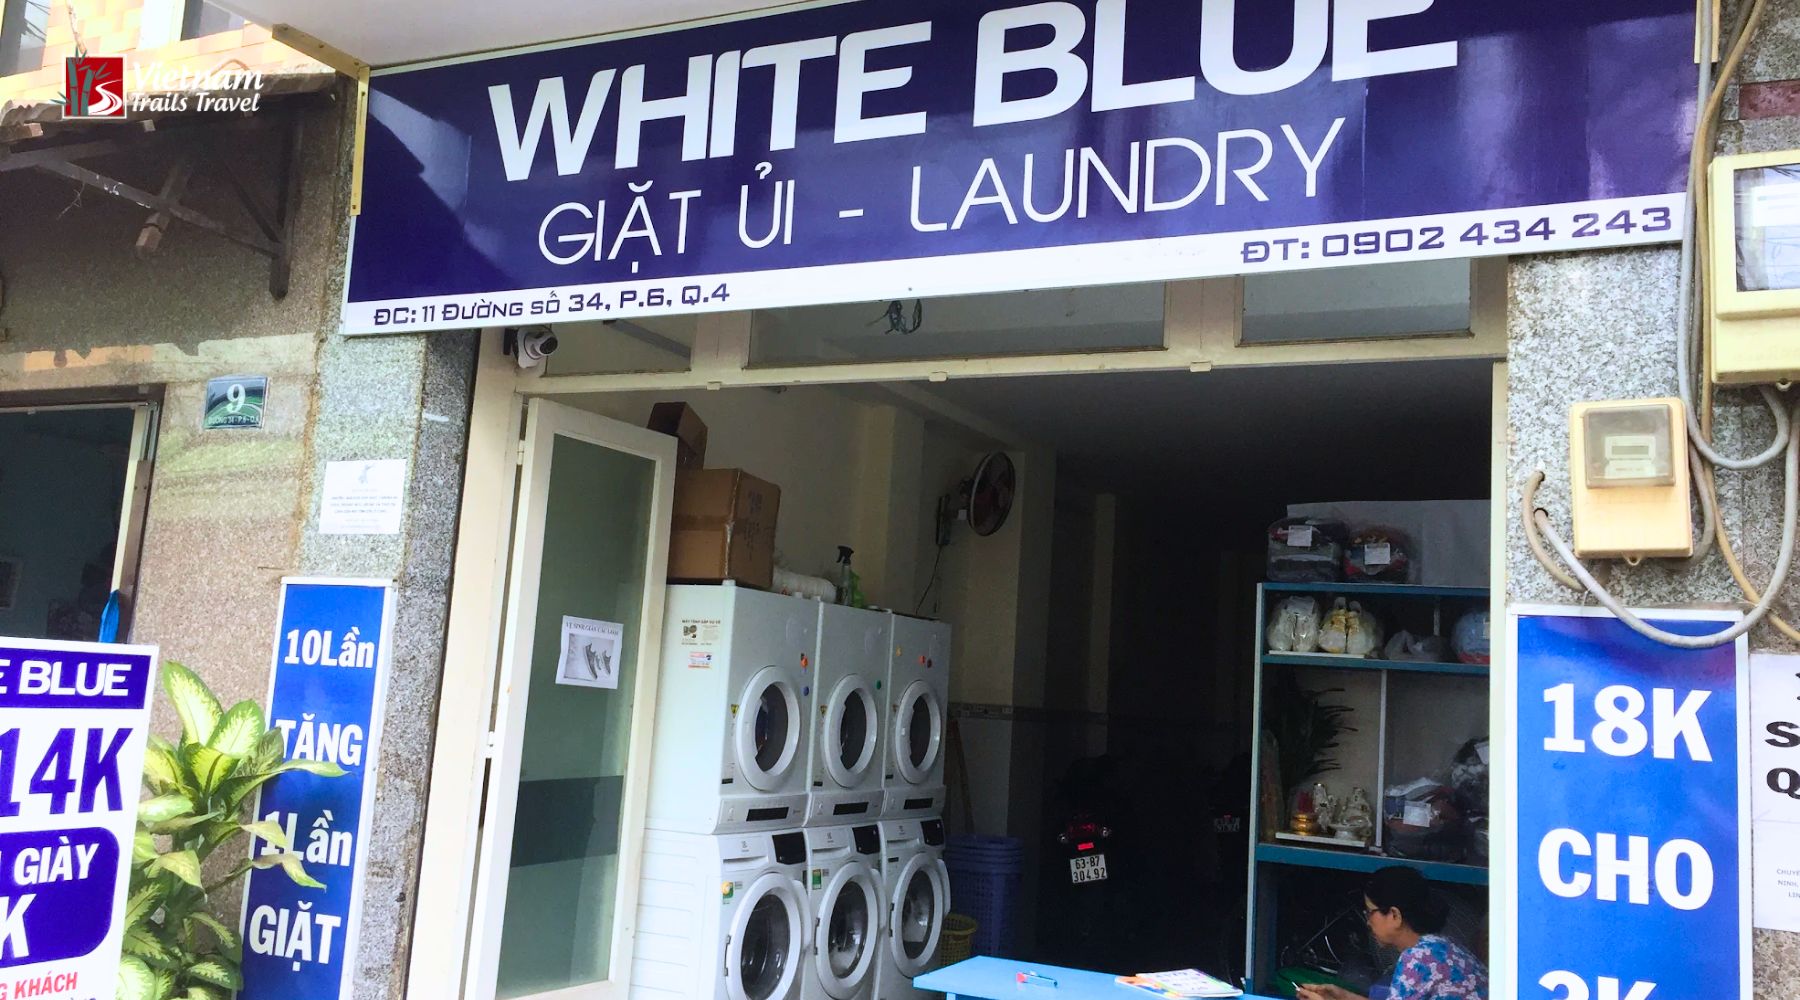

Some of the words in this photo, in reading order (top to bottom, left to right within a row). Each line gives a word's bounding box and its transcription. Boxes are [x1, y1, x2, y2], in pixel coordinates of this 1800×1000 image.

[487, 21, 932, 182] WHITE
[973, 0, 1458, 128] BLUE
[538, 180, 702, 274] GIẶT
[738, 161, 796, 249] ỦI
[909, 117, 1346, 233] LAUNDRY
[1240, 238, 1310, 264] ĐT:
[1322, 226, 1445, 258] 0902
[1459, 217, 1556, 246] 434
[1571, 207, 1672, 239] 243
[373, 307, 417, 326] ĐC:
[422, 305, 435, 323] 11
[568, 292, 611, 312] 34,
[619, 287, 672, 309] P.6,
[681, 283, 730, 306] Q.4
[226, 383, 246, 413] 9
[284, 626, 376, 668] 10Lần
[18, 660, 132, 696] BLUE
[275, 712, 363, 766] TĂNG
[1543, 683, 1712, 762] 18K
[0, 728, 133, 817] 14K
[13, 836, 100, 886] GIÀY
[260, 810, 353, 866] 1Lần
[1538, 828, 1714, 910] CHO
[249, 901, 341, 972] GIẶT
[14, 970, 79, 1000] KHÁCH
